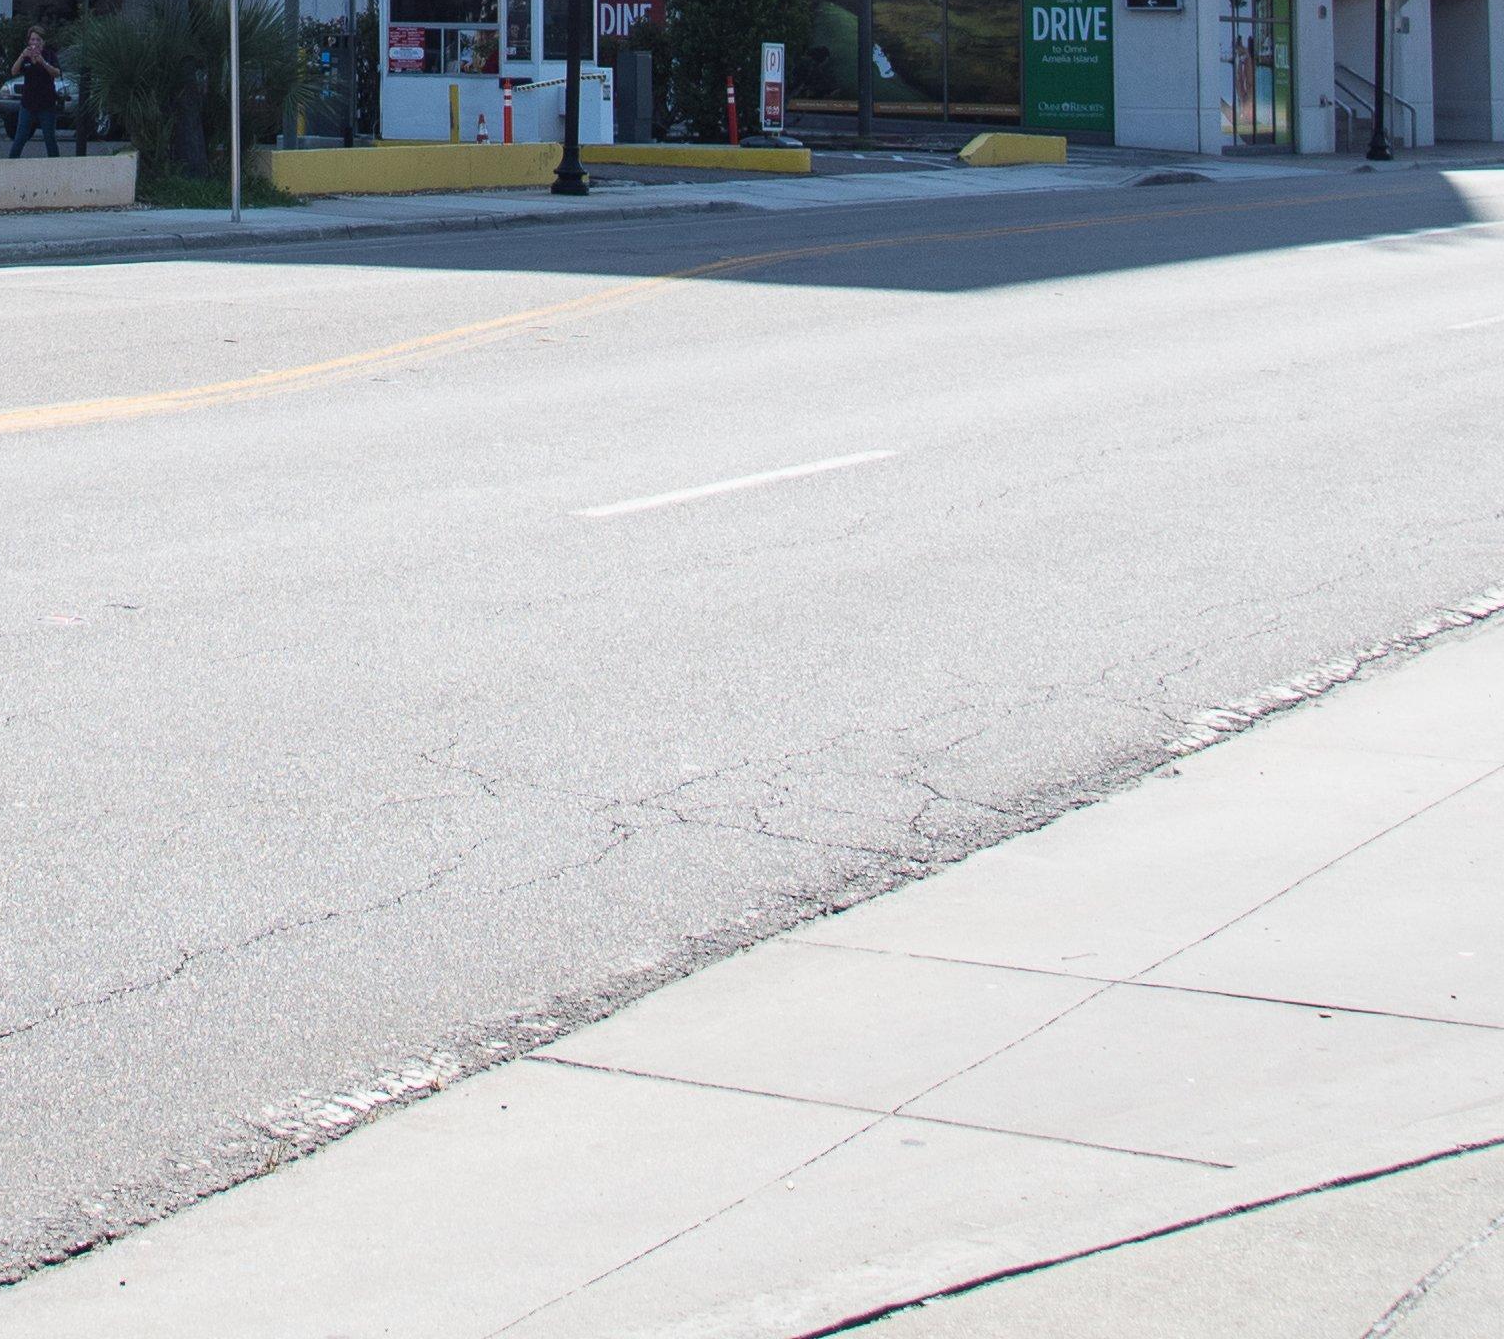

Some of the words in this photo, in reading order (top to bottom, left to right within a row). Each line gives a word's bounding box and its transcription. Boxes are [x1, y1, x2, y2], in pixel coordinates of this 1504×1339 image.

[1032, 6, 1108, 42] DRIVE
[1052, 46, 1061, 54] to
[1064, 46, 1088, 54] Omni
[1042, 55, 1072, 64] Amelia
[1073, 55, 1099, 64] Island
